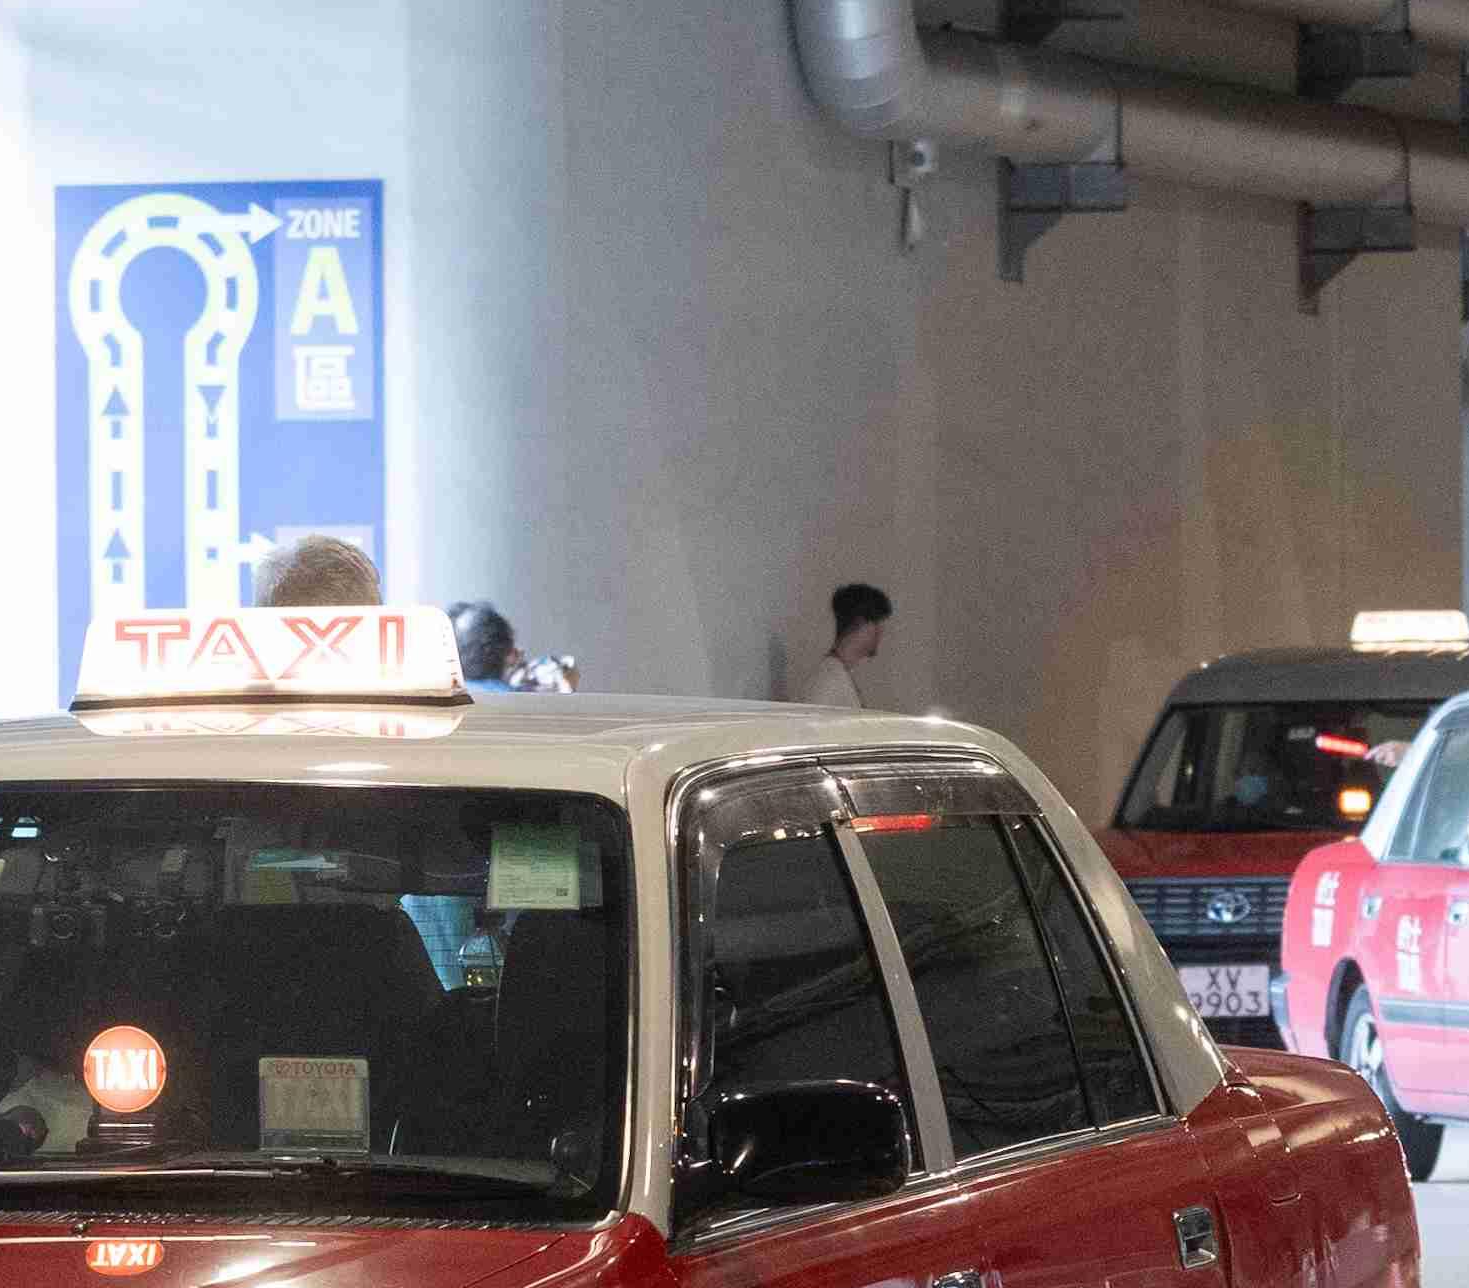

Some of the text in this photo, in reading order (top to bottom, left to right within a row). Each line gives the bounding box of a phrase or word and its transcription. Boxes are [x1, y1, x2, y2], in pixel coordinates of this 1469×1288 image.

[286, 209, 360, 240] ZONE
[290, 247, 359, 335] A
[293, 345, 356, 410] 區
[115, 616, 406, 681] TAXI
[1205, 968, 1242, 988] XV
[89, 1048, 158, 1090] TAXI
[292, 1062, 356, 1076] TOYOTA
